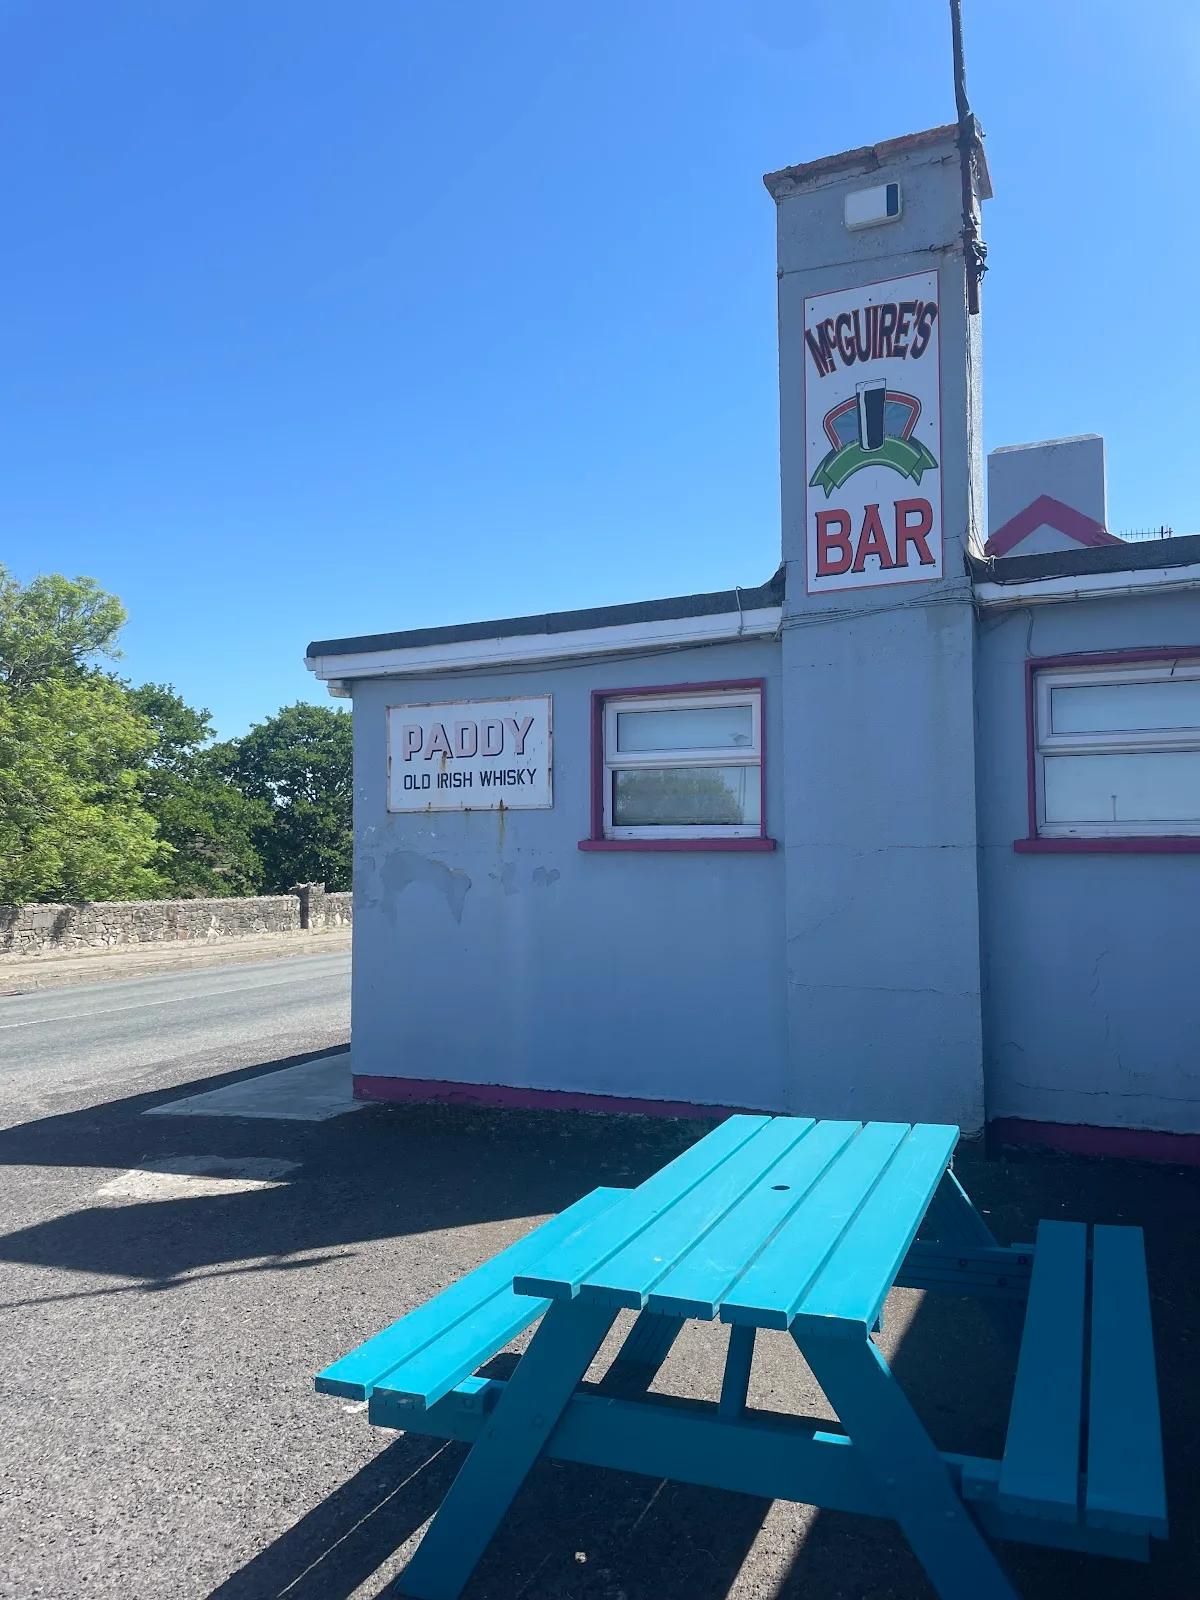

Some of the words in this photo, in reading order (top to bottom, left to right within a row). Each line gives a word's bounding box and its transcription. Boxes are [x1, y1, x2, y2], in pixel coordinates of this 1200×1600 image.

[815, 498, 936, 577] BAR
[402, 717, 534, 761] PADDY
[403, 774, 431, 790] OLD
[437, 771, 473, 789] IRISH
[479, 768, 537, 787] WHISKY
